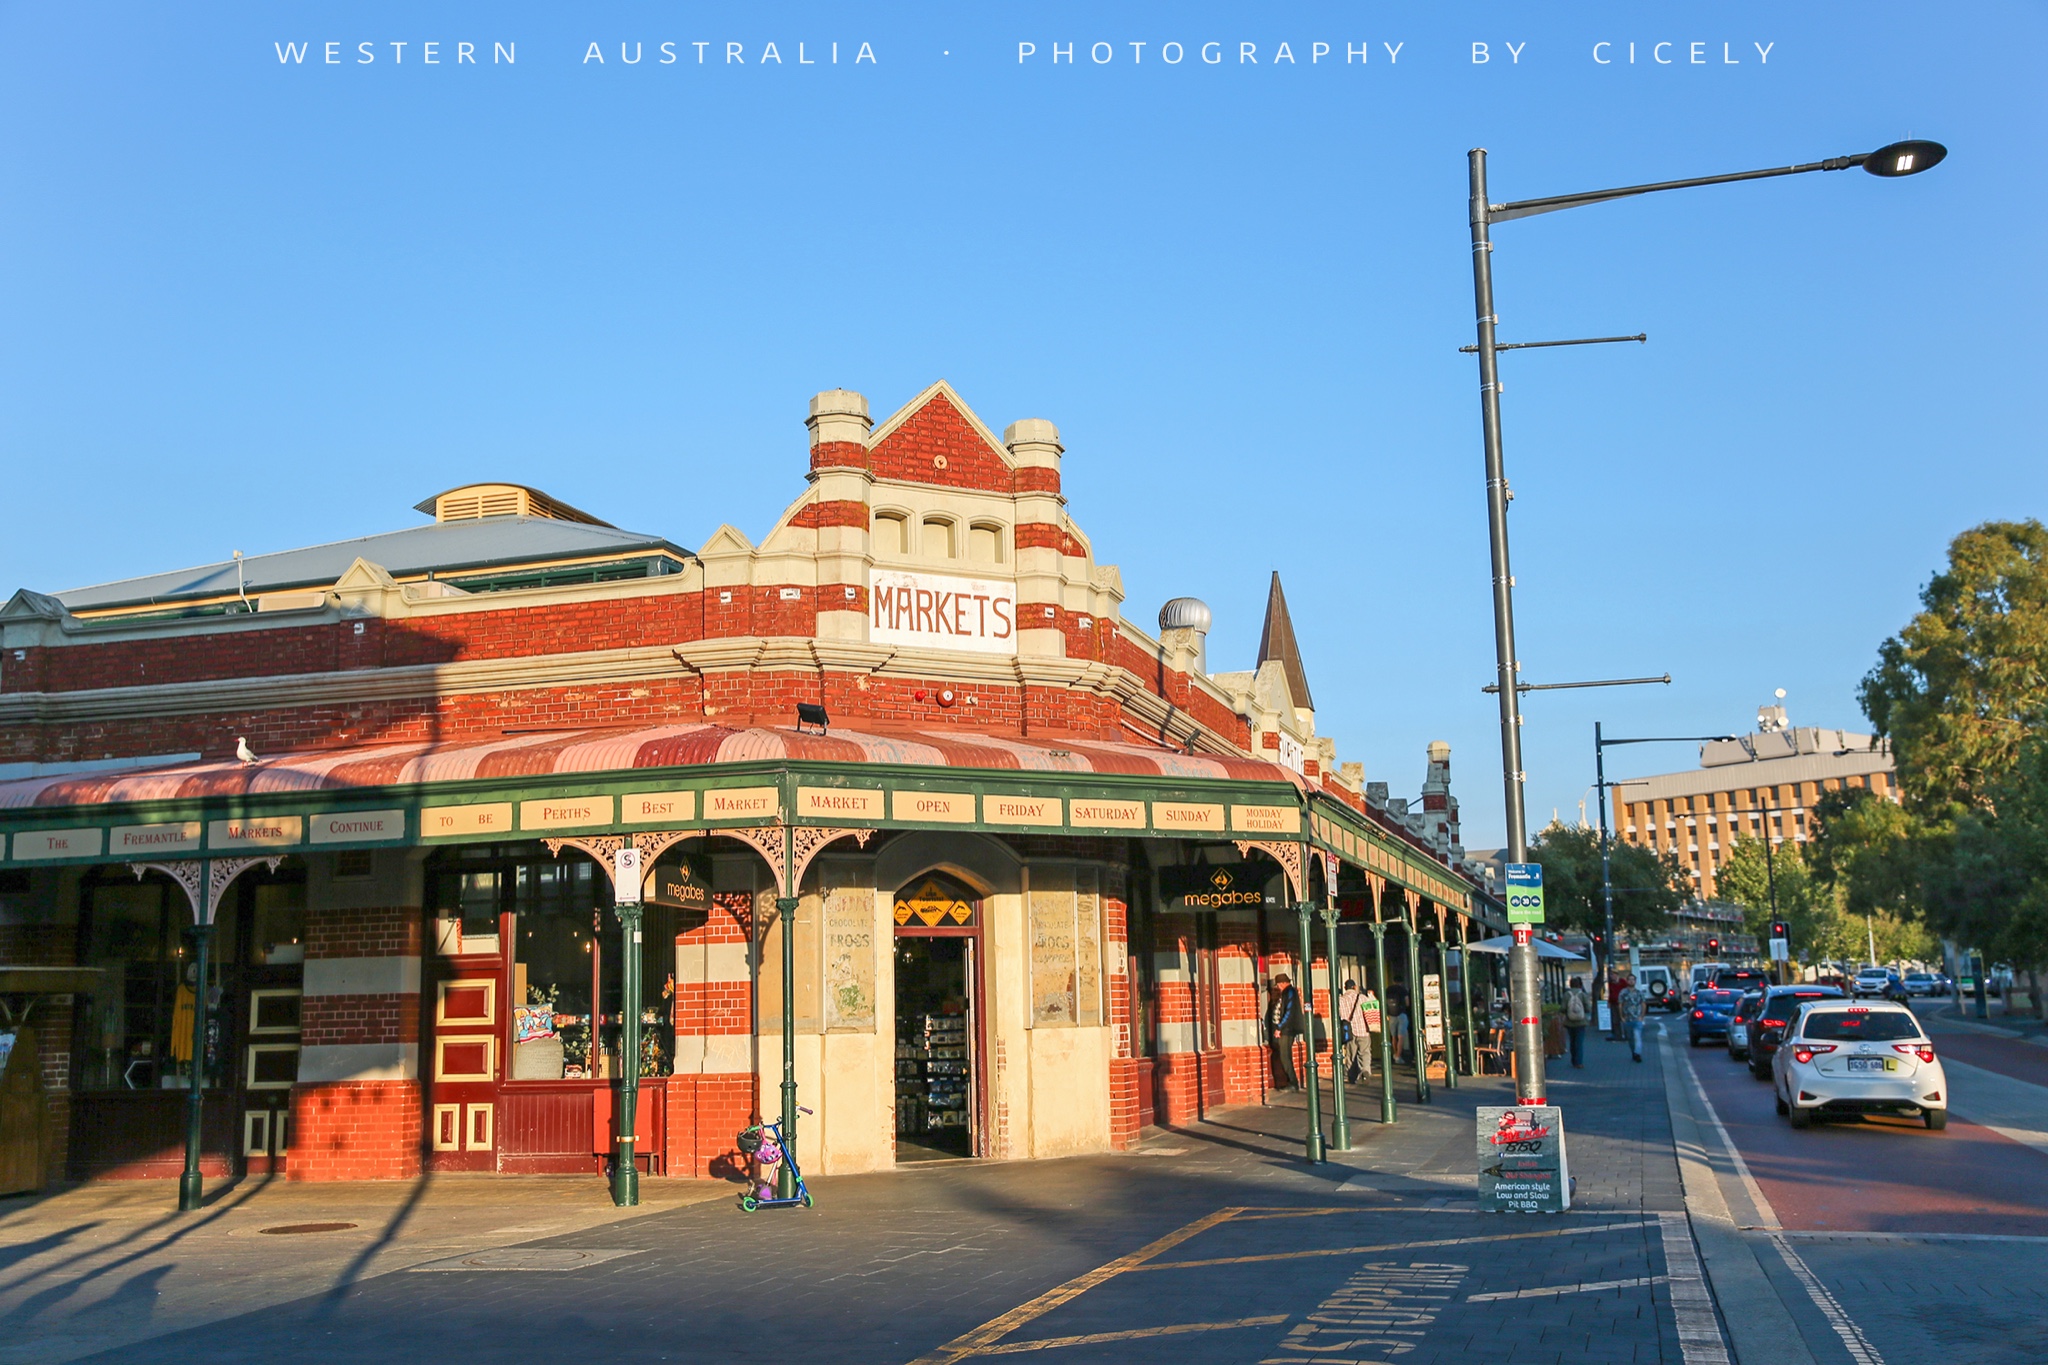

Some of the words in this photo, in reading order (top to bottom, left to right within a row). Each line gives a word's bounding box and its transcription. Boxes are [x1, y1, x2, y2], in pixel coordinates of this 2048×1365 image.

[874, 585, 1012, 639] MARKETS
[810, 795, 869, 810] MARKET
[916, 799, 951, 813] OPEN
[999, 803, 1045, 817] FRIDAY
[1075, 806, 1139, 821] SATURDAY
[1166, 809, 1212, 823] SUNDAY
[1246, 807, 1283, 819] MONDAY
[47, 836, 69, 850] THE
[123, 830, 187, 846] FREMANTLE
[228, 825, 283, 841] MARKETS
[329, 820, 384, 834] CONTINUE
[439, 816, 454, 827] TO
[478, 813, 494, 825] BE
[543, 806, 592, 821] PERTH'S
[641, 801, 675, 815] BEST
[714, 797, 769, 812] MARKET
[1246, 818, 1285, 830] HOLIDAY
[667, 881, 705, 902] megabes
[1184, 889, 1262, 909] megabes
[1505, 1140, 1543, 1154] BBQ
[1494, 1182, 1530, 1190] American
[1531, 1183, 1551, 1192] style
[1496, 1191, 1513, 1199] Low
[1529, 1191, 1550, 1199] Slow
[1508, 1200, 1520, 1208] Pit
[1520, 1200, 1539, 1209] BBQ
